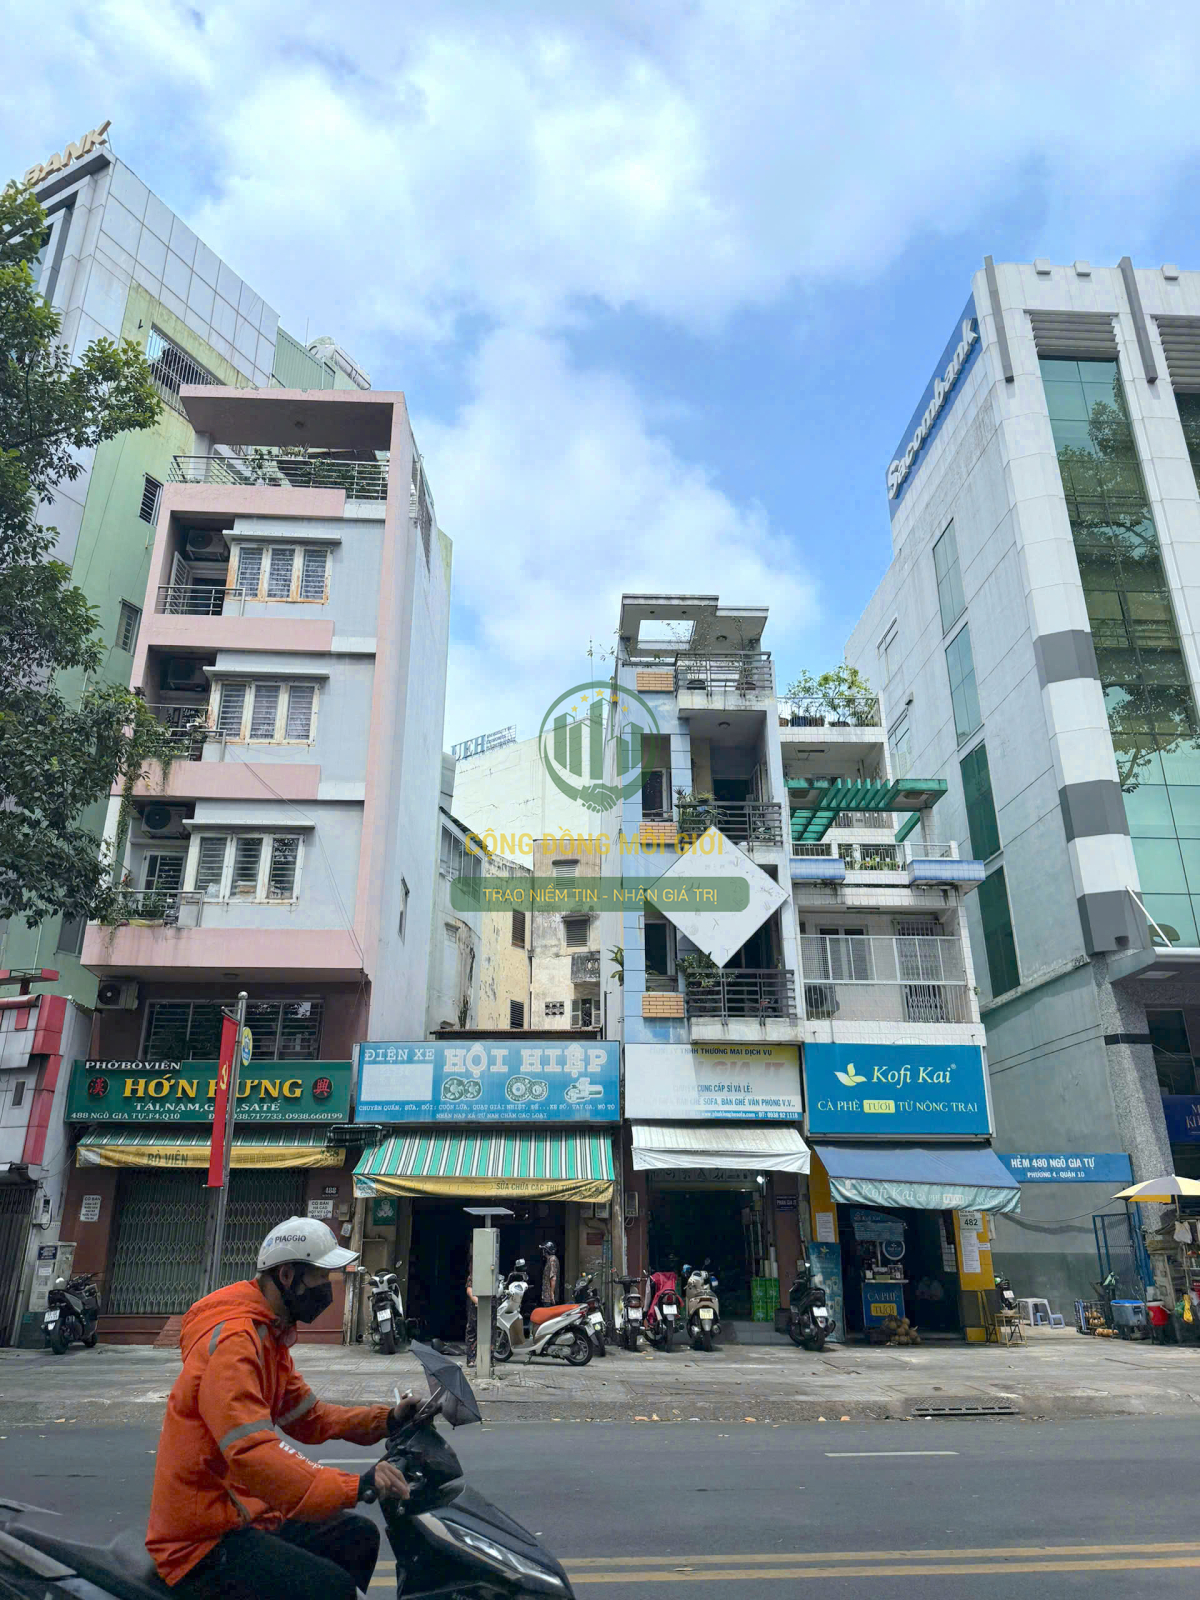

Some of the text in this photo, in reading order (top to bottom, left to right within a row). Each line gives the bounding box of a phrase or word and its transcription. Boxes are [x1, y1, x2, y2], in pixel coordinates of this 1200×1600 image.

[23, 120, 111, 188] BANK
[888, 317, 979, 499] Sacombank
[365, 1047, 434, 1063] ĐIỆN XE
[701, 1046, 727, 1055] THƯƠNG
[444, 1043, 607, 1078] HỘI HIỆP
[872, 1064, 951, 1088] Kofi Kai
[88, 1078, 105, 1096] 漢
[122, 1074, 200, 1098] HỚN
[313, 1079, 331, 1096] 興
[714, 1082, 726, 1093] CẤP
[134, 1100, 281, 1113] TÁI,NẠM,G,SATẾ
[703, 1098, 720, 1107] SOFA,
[721, 1096, 733, 1106] BÀN
[735, 1095, 747, 1106] GHẾ
[761, 1097, 781, 1107] PHÒNG
[818, 1098, 978, 1114] CÀ PHÊ TƯƠI TỪ NÔNG TRẠI
[90, 1111, 109, 1119] NGÔ
[147, 1149, 161, 1165] BÒ
[164, 1150, 188, 1166] VIÊN
[1011, 1155, 1095, 1169] HẺM 480 NGÔ GIA TỰ
[531, 1183, 544, 1191] CÁC
[862, 1184, 888, 1200] Kofi
[892, 1185, 914, 1201] Kai
[274, 1234, 307, 1244] PIAGGIO
